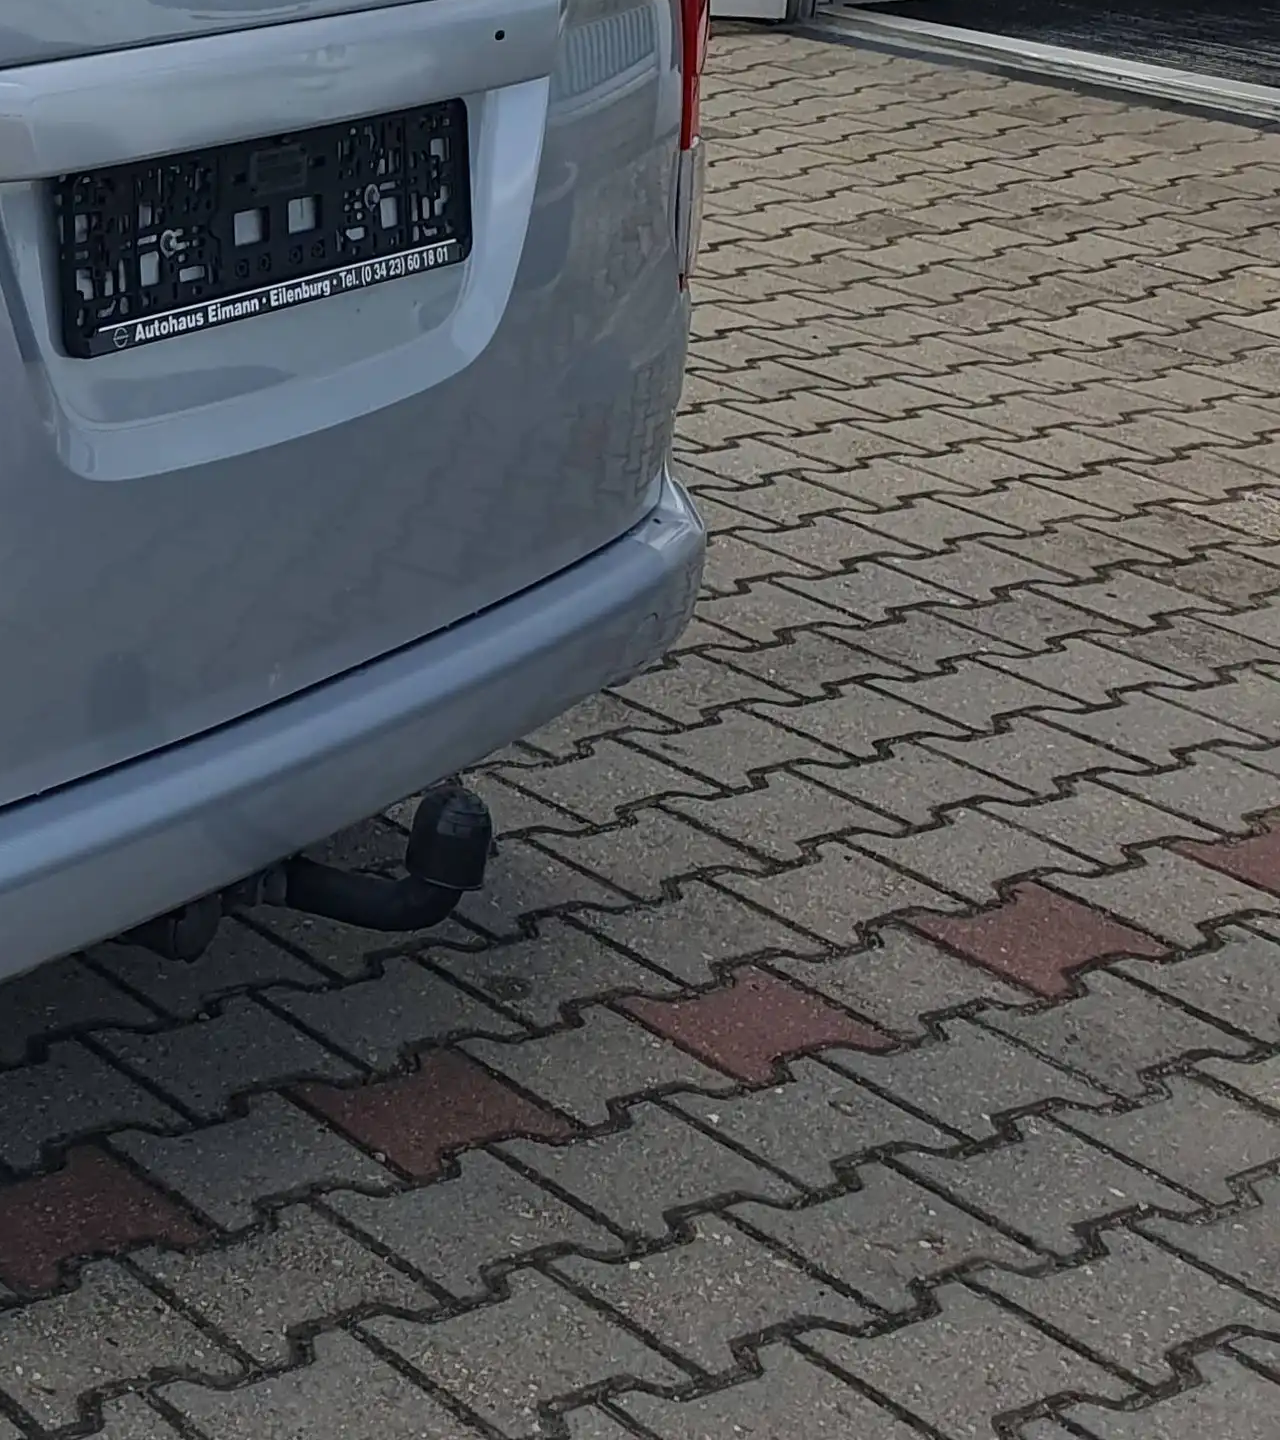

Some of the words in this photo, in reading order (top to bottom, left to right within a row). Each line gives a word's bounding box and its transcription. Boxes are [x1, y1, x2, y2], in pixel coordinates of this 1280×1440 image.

[134, 311, 205, 342] Autohaus
[208, 298, 260, 323] Eimann
[269, 280, 331, 307] Eilenburg
[339, 268, 359, 288] Tel.
[374, 262, 387, 279] 34
[388, 257, 406, 276] 23)
[407, 253, 420, 271] 60
[422, 249, 435, 267] 18
[436, 246, 449, 264] 01
